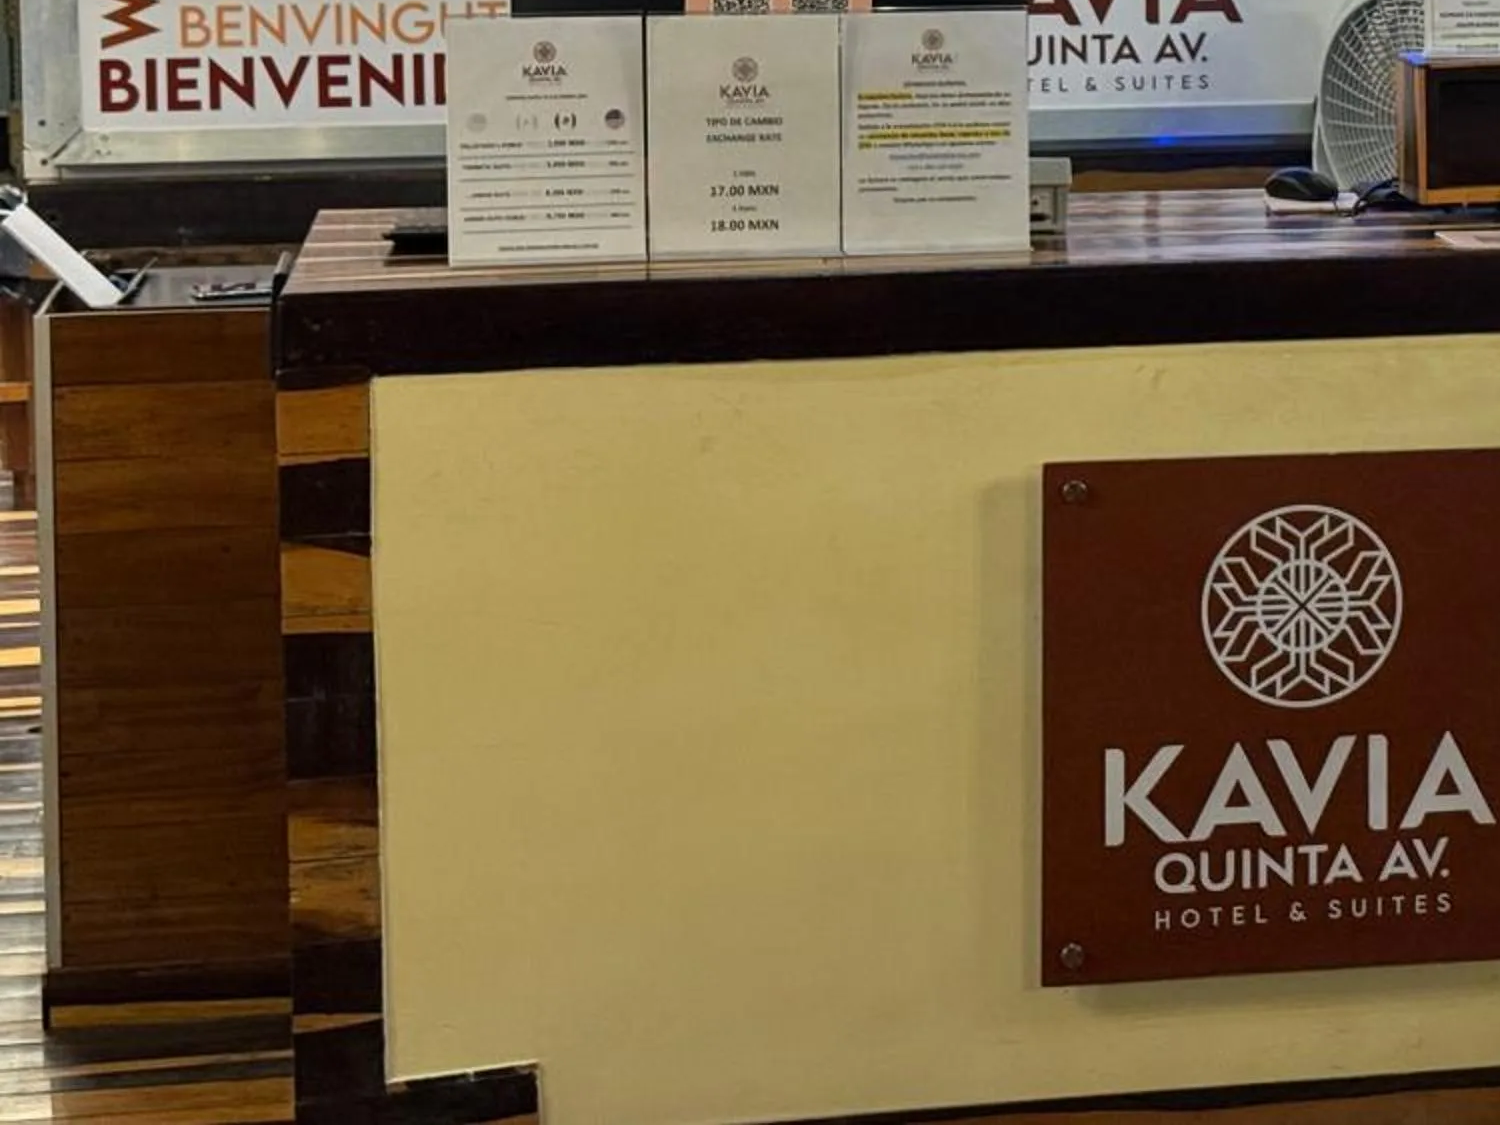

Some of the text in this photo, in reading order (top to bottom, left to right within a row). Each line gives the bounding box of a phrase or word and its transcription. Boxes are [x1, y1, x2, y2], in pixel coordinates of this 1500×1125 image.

[1154, 31, 1208, 63] AV.
[719, 85, 769, 98] KAVIA
[1115, 74, 1210, 92] SUITES
[710, 184, 780, 197] 17.00 MXN
[747, 219, 780, 230] MXN
[1104, 730, 1497, 848] KAVIA
[1154, 836, 1451, 895] QUINTA AV.
[1155, 892, 1452, 931] HOTEL & SUITES
